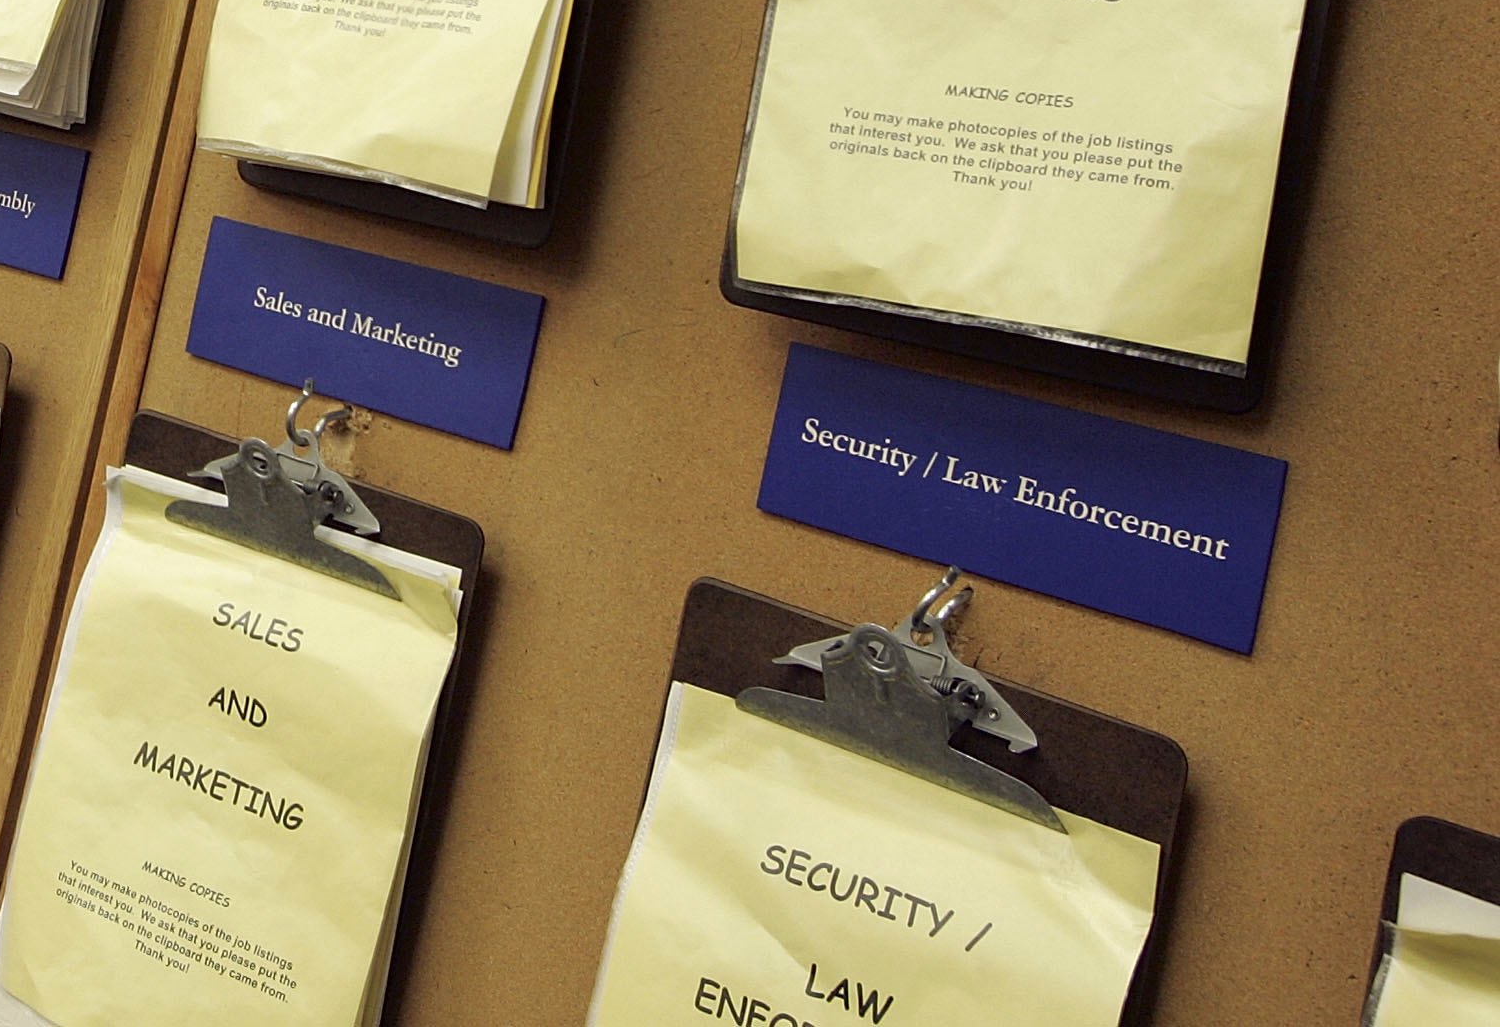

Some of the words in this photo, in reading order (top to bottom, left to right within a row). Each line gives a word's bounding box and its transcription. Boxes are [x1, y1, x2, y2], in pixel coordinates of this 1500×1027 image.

[944, 84, 1009, 101] MAKING
[1015, 91, 1073, 108] COPIES
[829, 122, 855, 135] that
[858, 124, 911, 142] interest
[914, 134, 944, 147] you.
[954, 136, 976, 150] We
[979, 141, 1005, 153] ask
[1009, 143, 1038, 157] that
[1041, 149, 1068, 161] you
[1072, 150, 1122, 165] please
[1126, 157, 1153, 169] put
[1158, 158, 1182, 172] the
[843, 106, 869, 120] You
[873, 112, 903, 127] may
[906, 116, 944, 129] make
[947, 119, 1037, 140] photocopies
[1042, 130, 1058, 141] of
[1060, 131, 1084, 144] the
[1086, 133, 1112, 148] job
[1116, 136, 1172, 155] listings
[829, 141, 888, 156] originals
[892, 146, 926, 161] back
[930, 153, 948, 163] on
[952, 154, 974, 166] the
[978, 157, 1048, 175] clipboard
[1052, 165, 1084, 182] they
[1087, 171, 1128, 184] came
[1133, 173, 1174, 190] from.
[952, 170, 995, 186] Thank
[998, 179, 1032, 191] you!
[253, 286, 302, 317] Sales
[307, 307, 346, 330] and
[349, 312, 461, 367] Marketing
[801, 417, 917, 476] Security
[922, 451, 938, 477] /
[941, 455, 1007, 493] Law
[1012, 475, 1229, 559] Enforcement
[212, 603, 303, 652] SALES
[207, 686, 267, 727] AND
[133, 741, 303, 830] MARKETING
[141, 860, 186, 887] MAKING
[189, 882, 230, 907] COPIES
[760, 845, 954, 937] SECURITY
[964, 922, 992, 951] /
[58, 871, 76, 887] that
[77, 882, 113, 904] interest
[140, 908, 156, 924] We
[157, 919, 175, 933] ask
[177, 927, 197, 944] that
[198, 938, 219, 953] you
[220, 949, 256, 970] please
[257, 966, 277, 980] put
[279, 973, 296, 988] the
[70, 859, 88, 876] You
[89, 871, 110, 888] may
[111, 881, 136, 899] make
[137, 894, 199, 928] photocopies
[201, 923, 214, 933] of
[214, 927, 231, 942] the
[231, 935, 251, 951] job
[253, 944, 292, 970] listings
[56, 888, 95, 912] originals
[97, 905, 119, 924] back
[121, 919, 134, 931] on
[136, 924, 152, 939] the
[154, 934, 202, 962] clipboard
[204, 955, 227, 975] they
[228, 969, 257, 988] came
[260, 981, 288, 1003] from.
[135, 939, 164, 962] Thank
[165, 956, 190, 973] you!
[805, 962, 894, 1024] LAW
